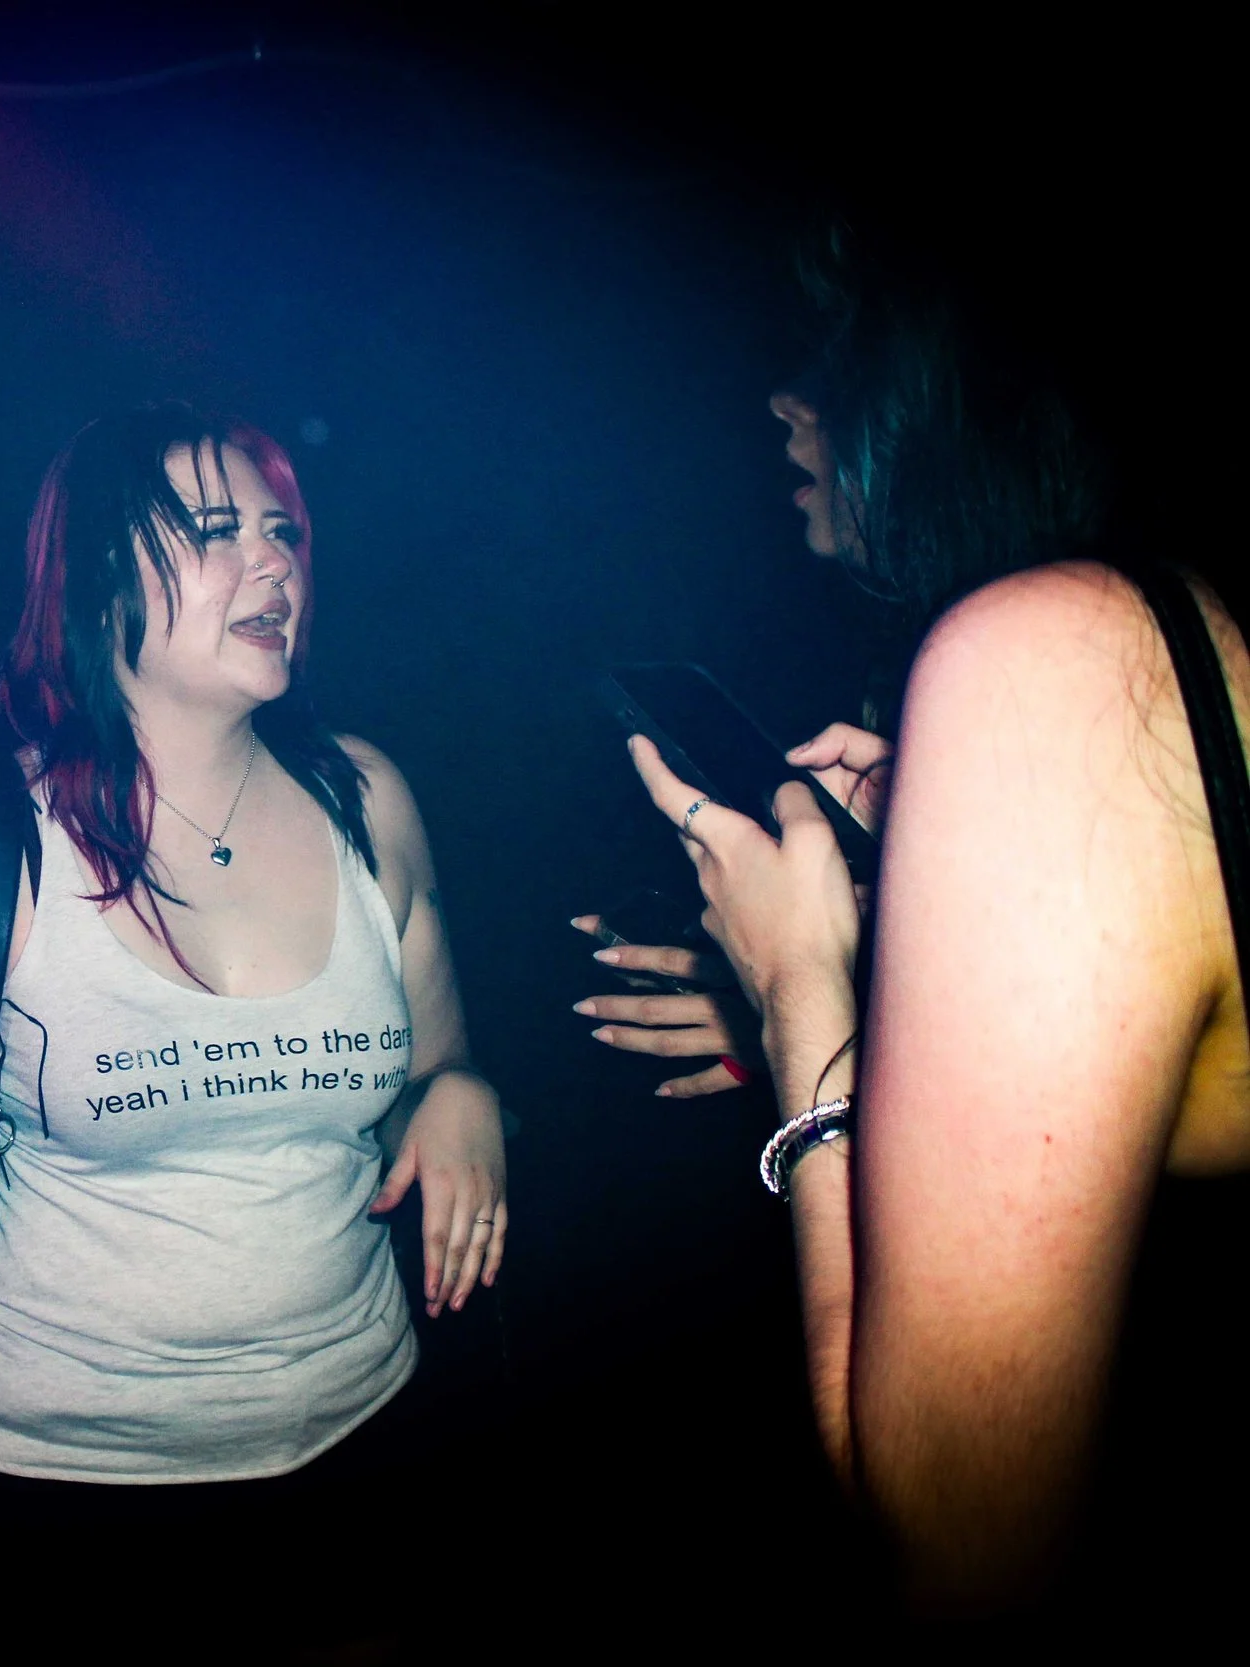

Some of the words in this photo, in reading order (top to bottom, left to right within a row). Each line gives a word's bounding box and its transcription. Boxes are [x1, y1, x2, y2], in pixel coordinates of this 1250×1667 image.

[96, 1040, 181, 1074] send
[192, 1037, 261, 1063] 'em
[274, 1033, 308, 1057] to
[322, 1028, 371, 1054] the
[86, 1084, 169, 1121] yeah
[181, 1079, 189, 1102] i
[203, 1069, 289, 1099] think
[301, 1068, 364, 1091] he's
[373, 1065, 407, 1090] with
